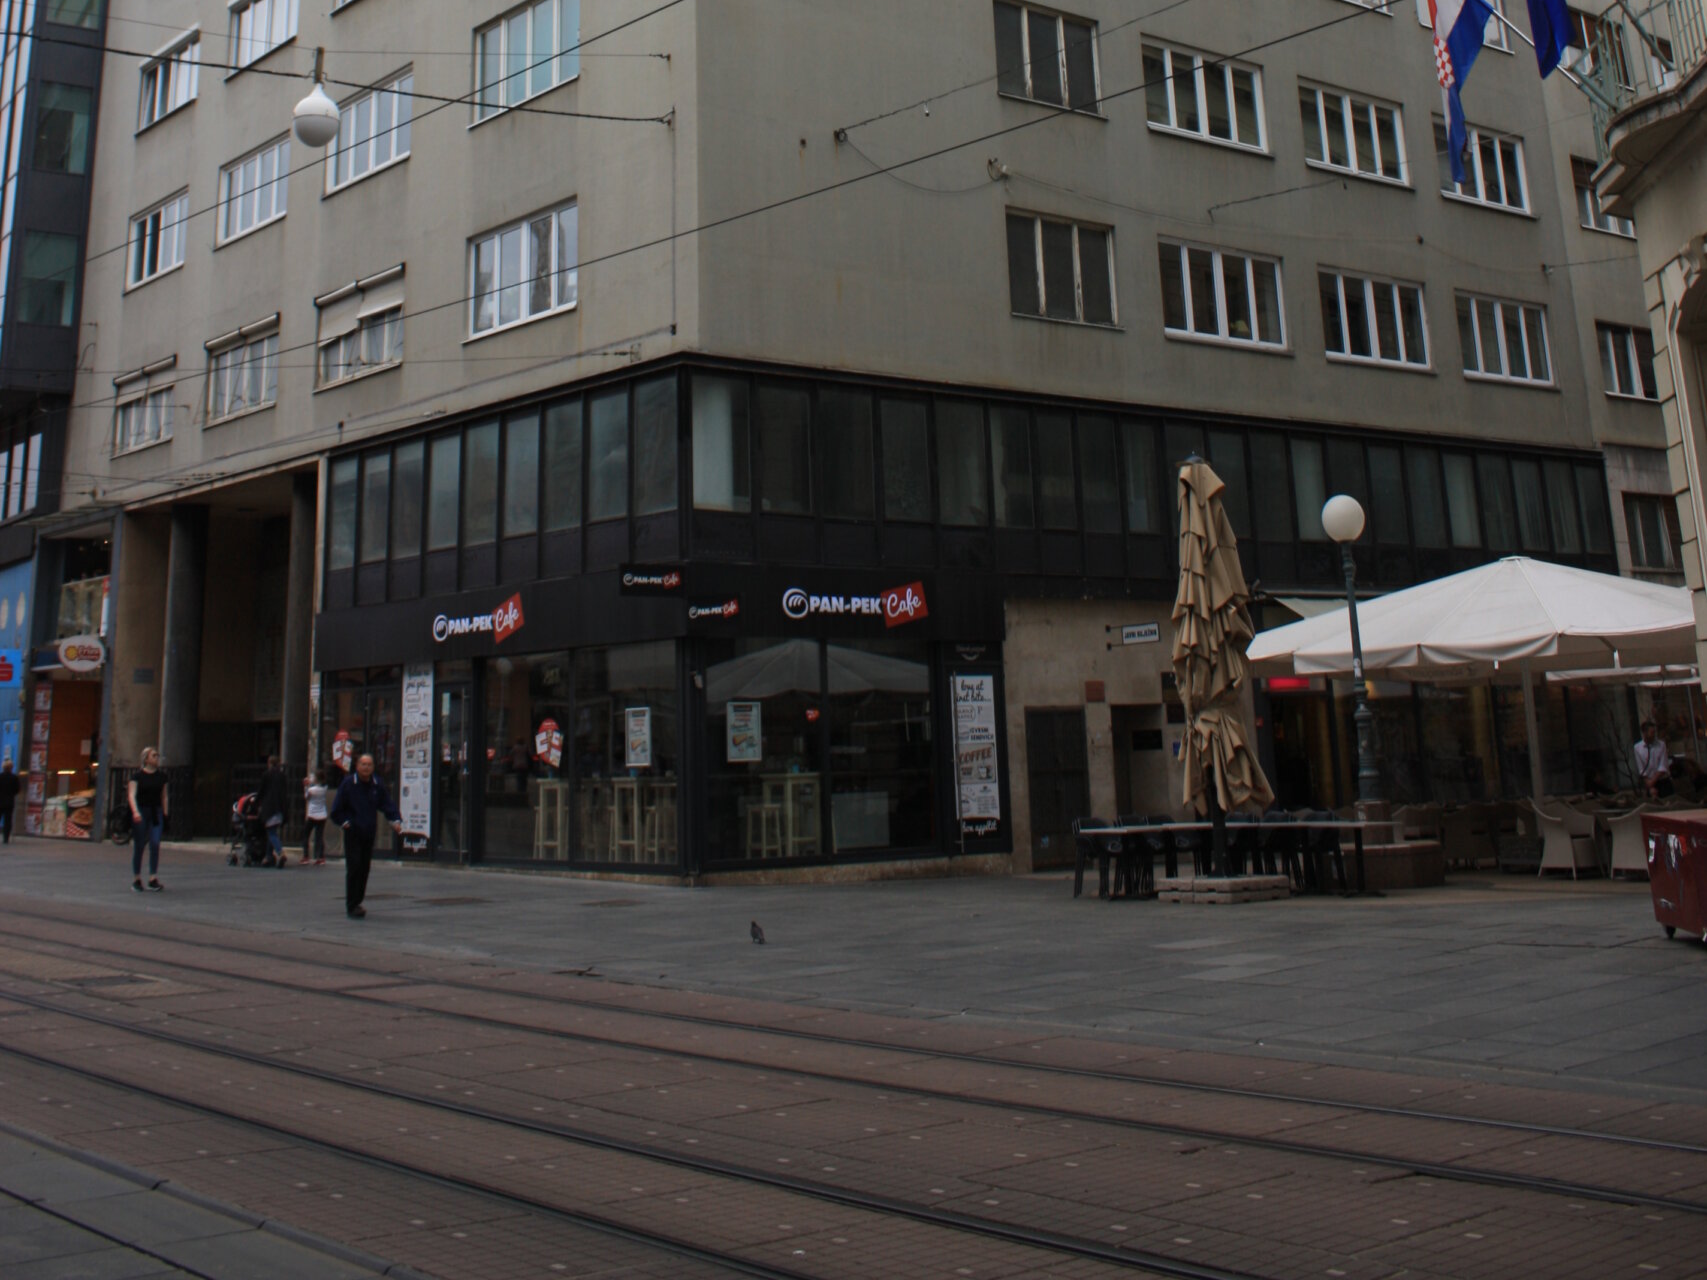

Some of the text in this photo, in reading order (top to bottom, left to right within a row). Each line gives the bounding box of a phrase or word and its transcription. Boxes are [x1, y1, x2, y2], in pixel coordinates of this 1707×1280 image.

[808, 587, 922, 618] PAN-PEK Cafe
[448, 601, 520, 636] PAN-PEK Cafe
[405, 729, 429, 748] COFFEE
[959, 747, 992, 763] COFFEE
